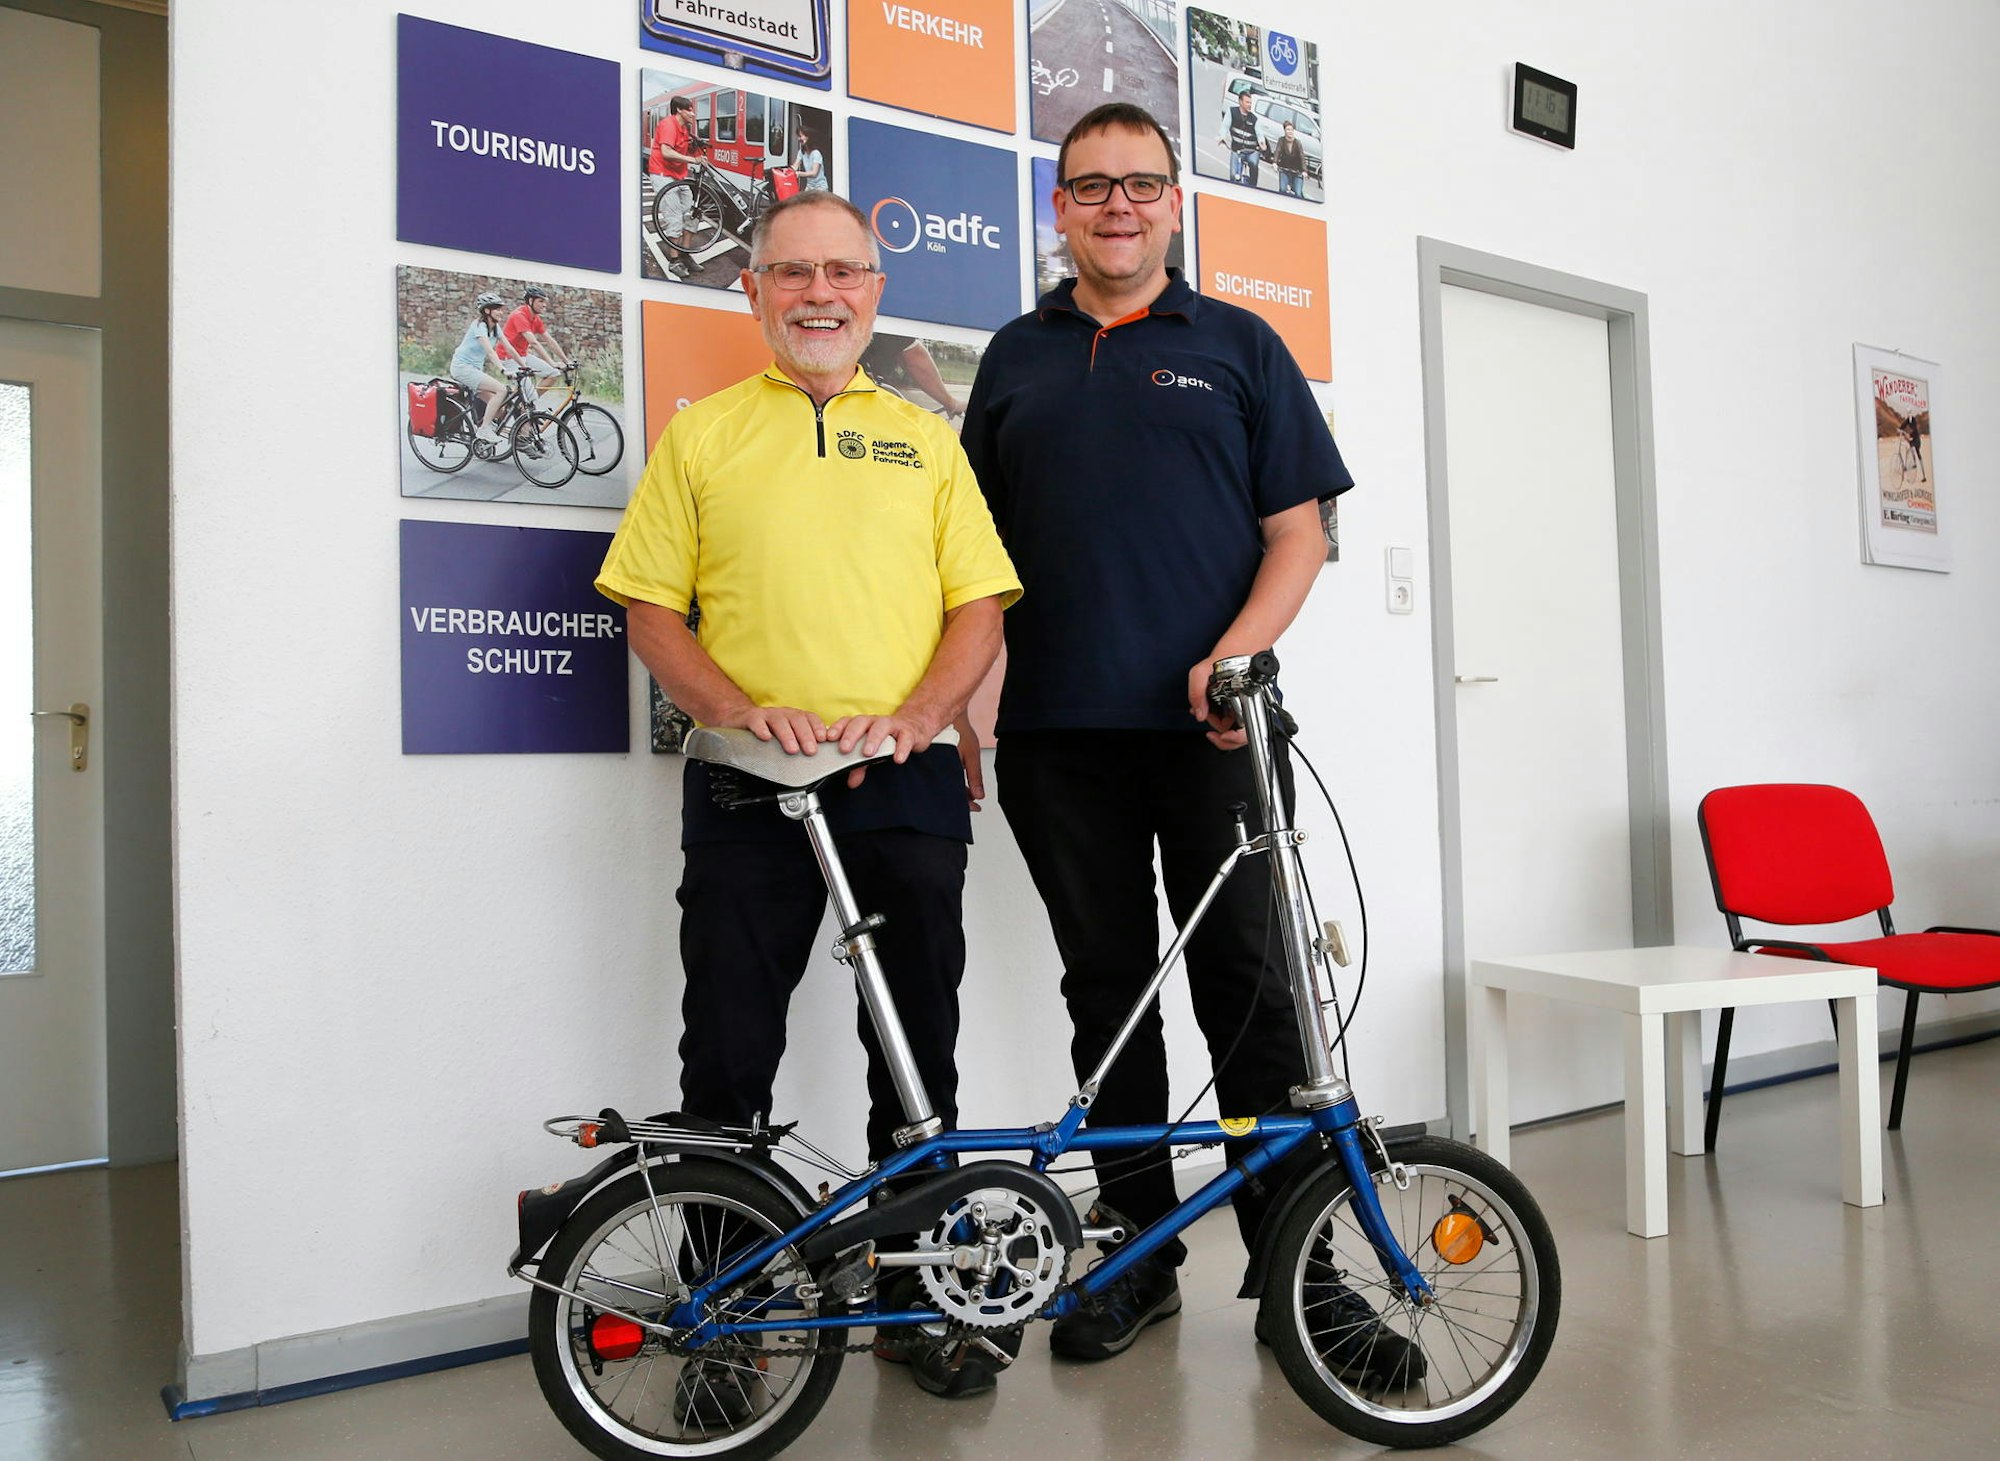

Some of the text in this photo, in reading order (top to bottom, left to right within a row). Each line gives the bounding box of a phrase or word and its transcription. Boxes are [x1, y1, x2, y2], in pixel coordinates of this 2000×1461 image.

[882, 2, 985, 49] VERKEHR
[431, 120, 596, 175] TOURISMUS
[925, 212, 1001, 250] adfc
[927, 241, 947, 254] Köln
[1215, 272, 1313, 309] SICHERHEIT
[836, 430, 865, 441] ADFC
[410, 607, 622, 638] VERBRAUCHER-
[466, 648, 573, 675] SCHUTZ
